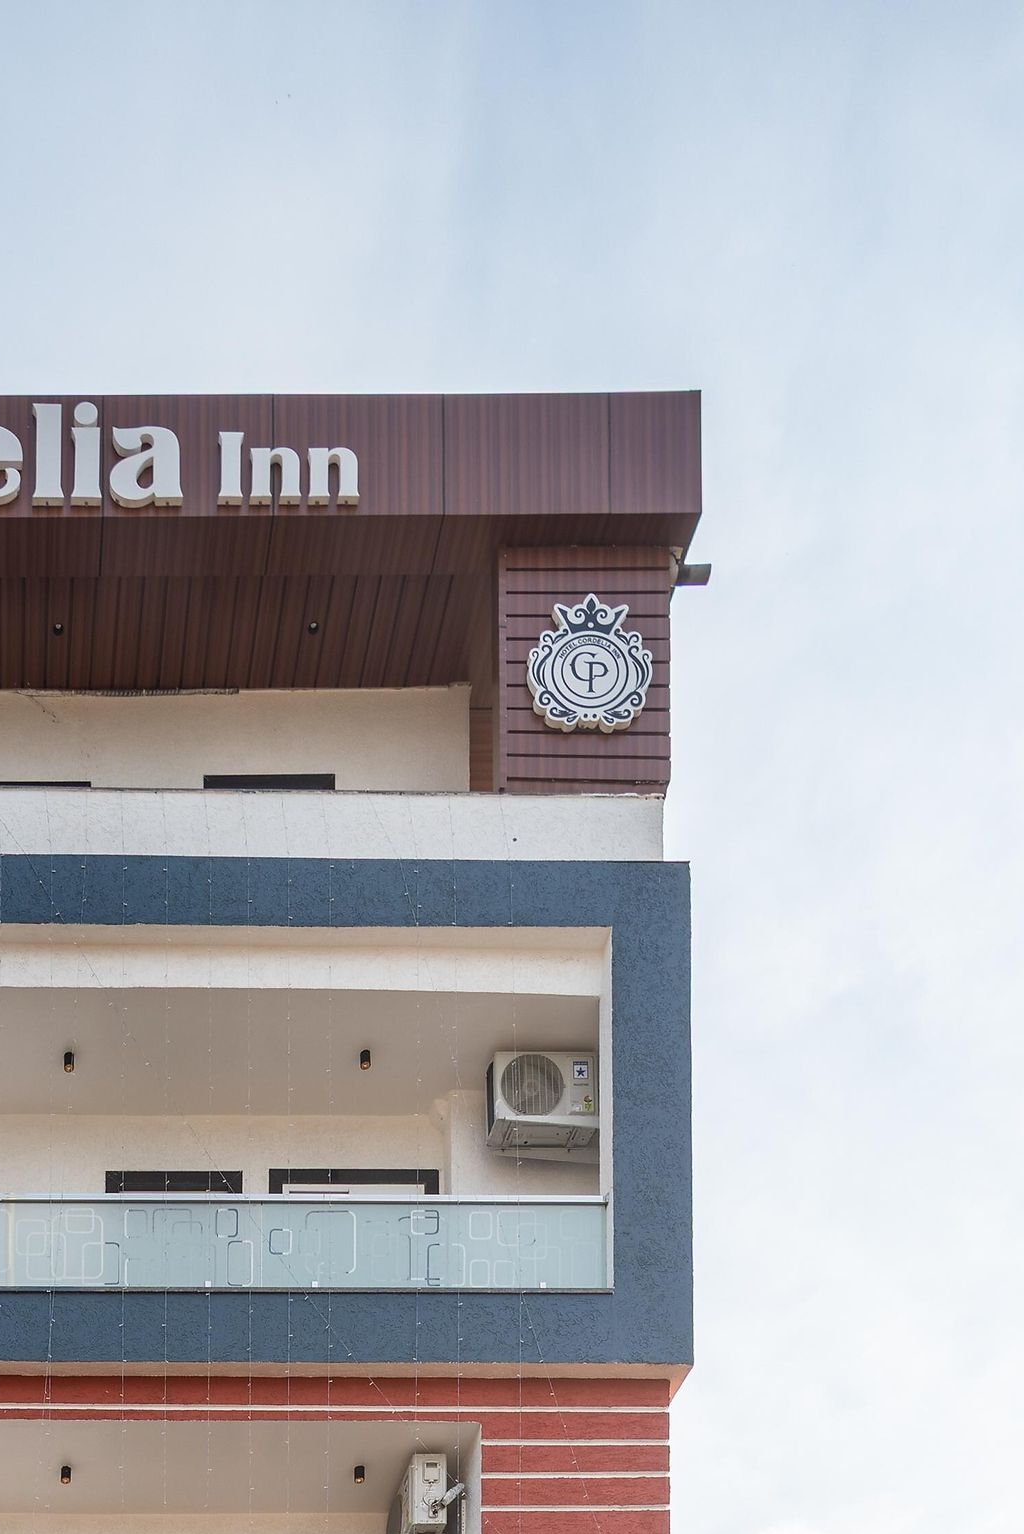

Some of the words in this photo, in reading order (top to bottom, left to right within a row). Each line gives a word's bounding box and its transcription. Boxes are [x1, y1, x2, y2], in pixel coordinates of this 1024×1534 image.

[216, 430, 361, 508] Inn
[559, 642, 577, 659] HOTEL
[578, 638, 611, 649] CORDELIA
[612, 648, 621, 659] INN
